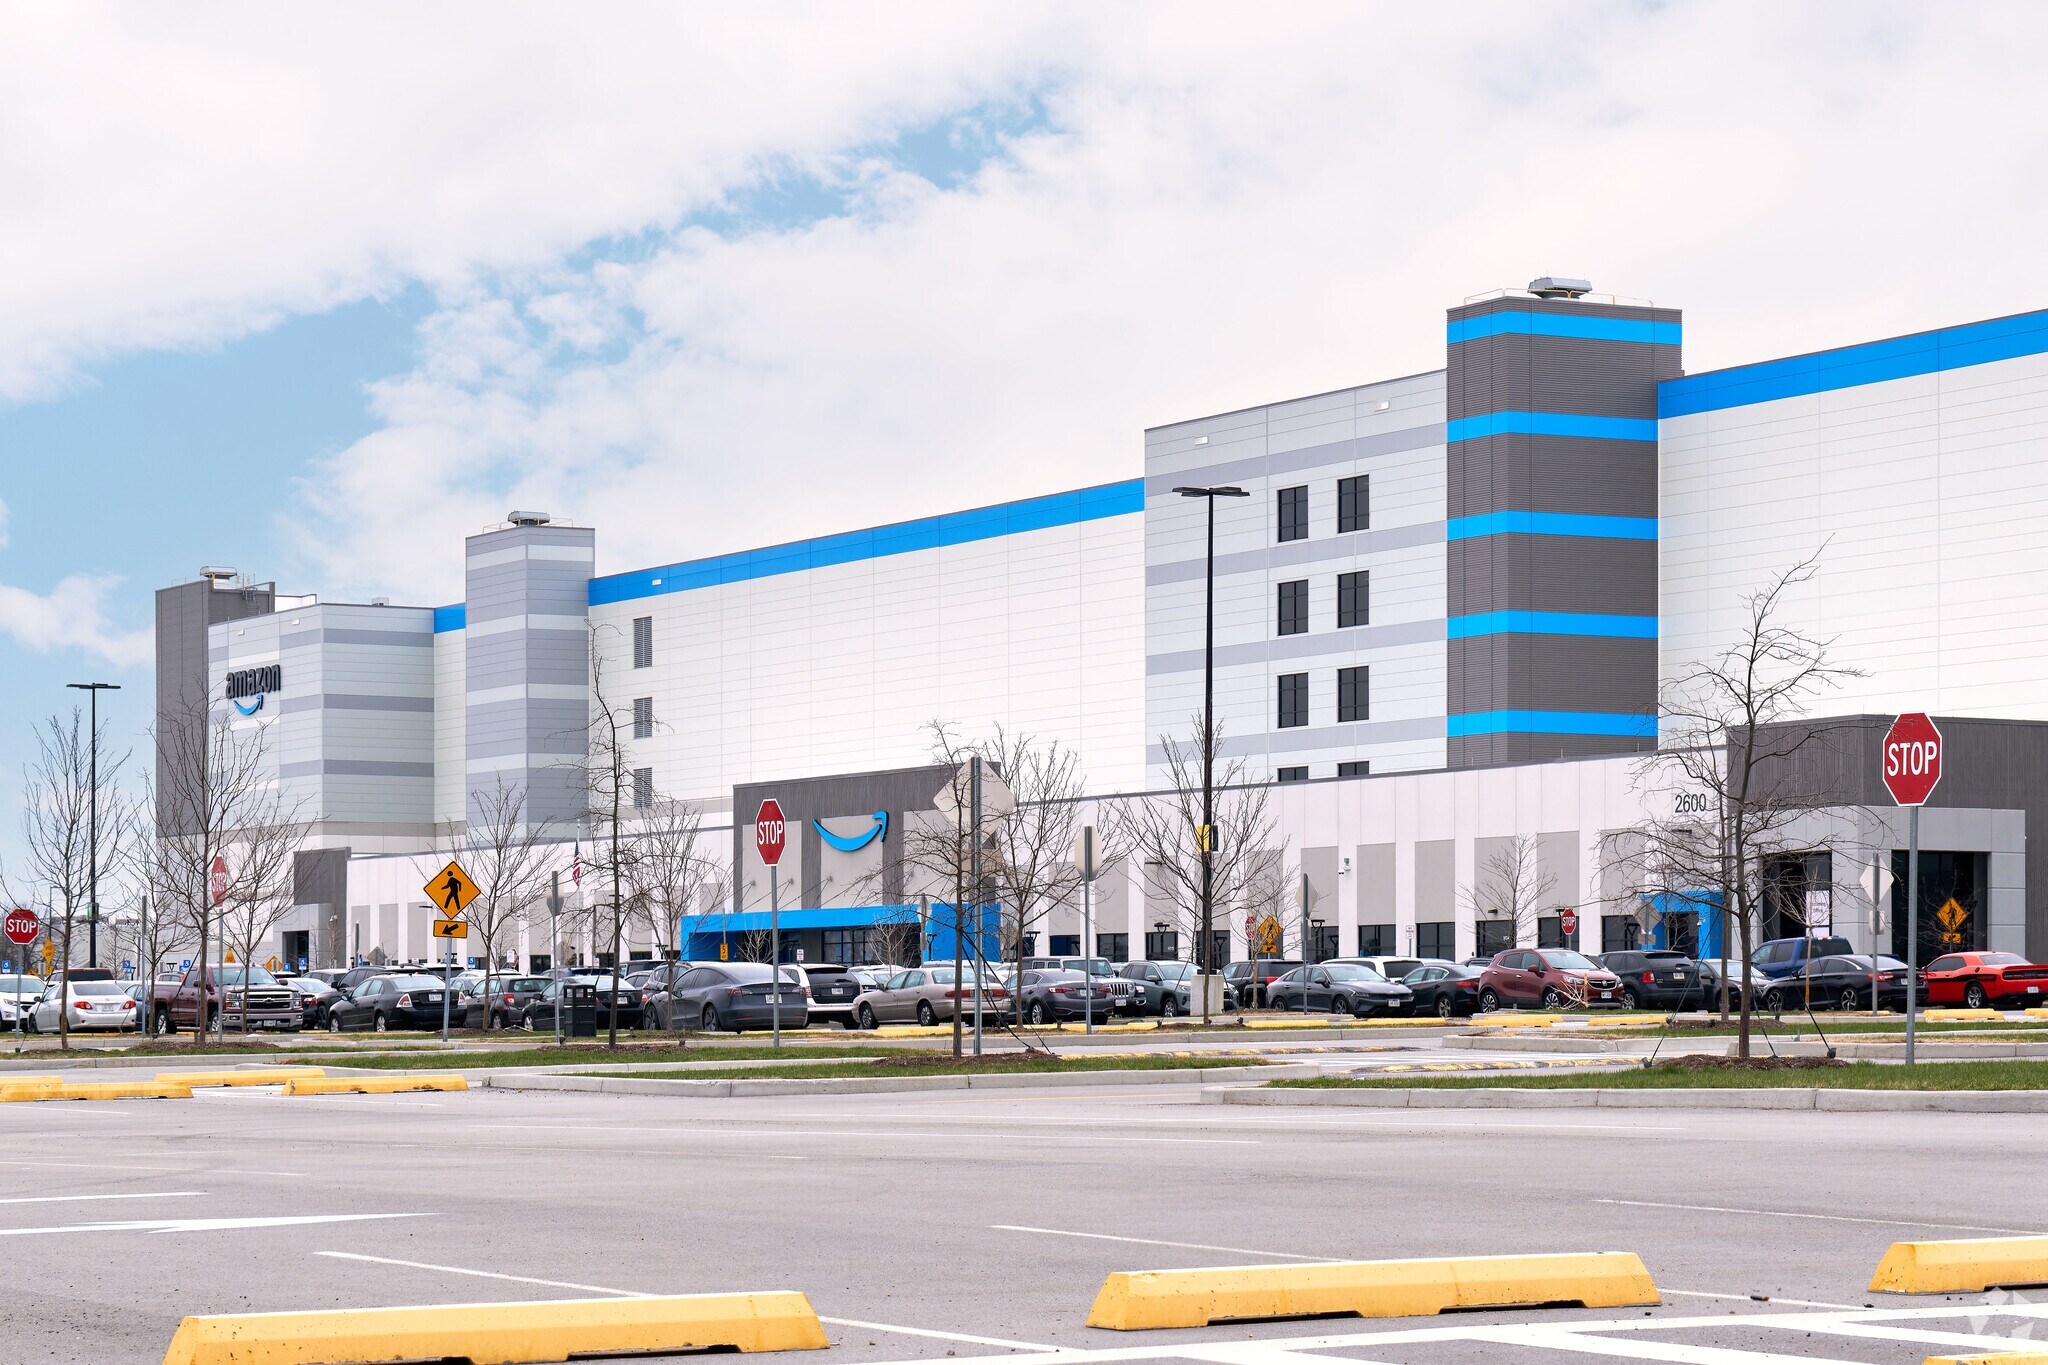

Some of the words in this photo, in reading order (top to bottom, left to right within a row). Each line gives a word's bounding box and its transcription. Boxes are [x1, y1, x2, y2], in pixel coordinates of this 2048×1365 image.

[225, 664, 281, 699] amazon
[1887, 741, 1938, 777] STOP
[1675, 793, 1707, 813] 2600
[758, 820, 784, 845] STOP
[212, 872, 227, 892] STOP
[7, 919, 37, 933] STOP
[1562, 916, 1575, 927] STOP
